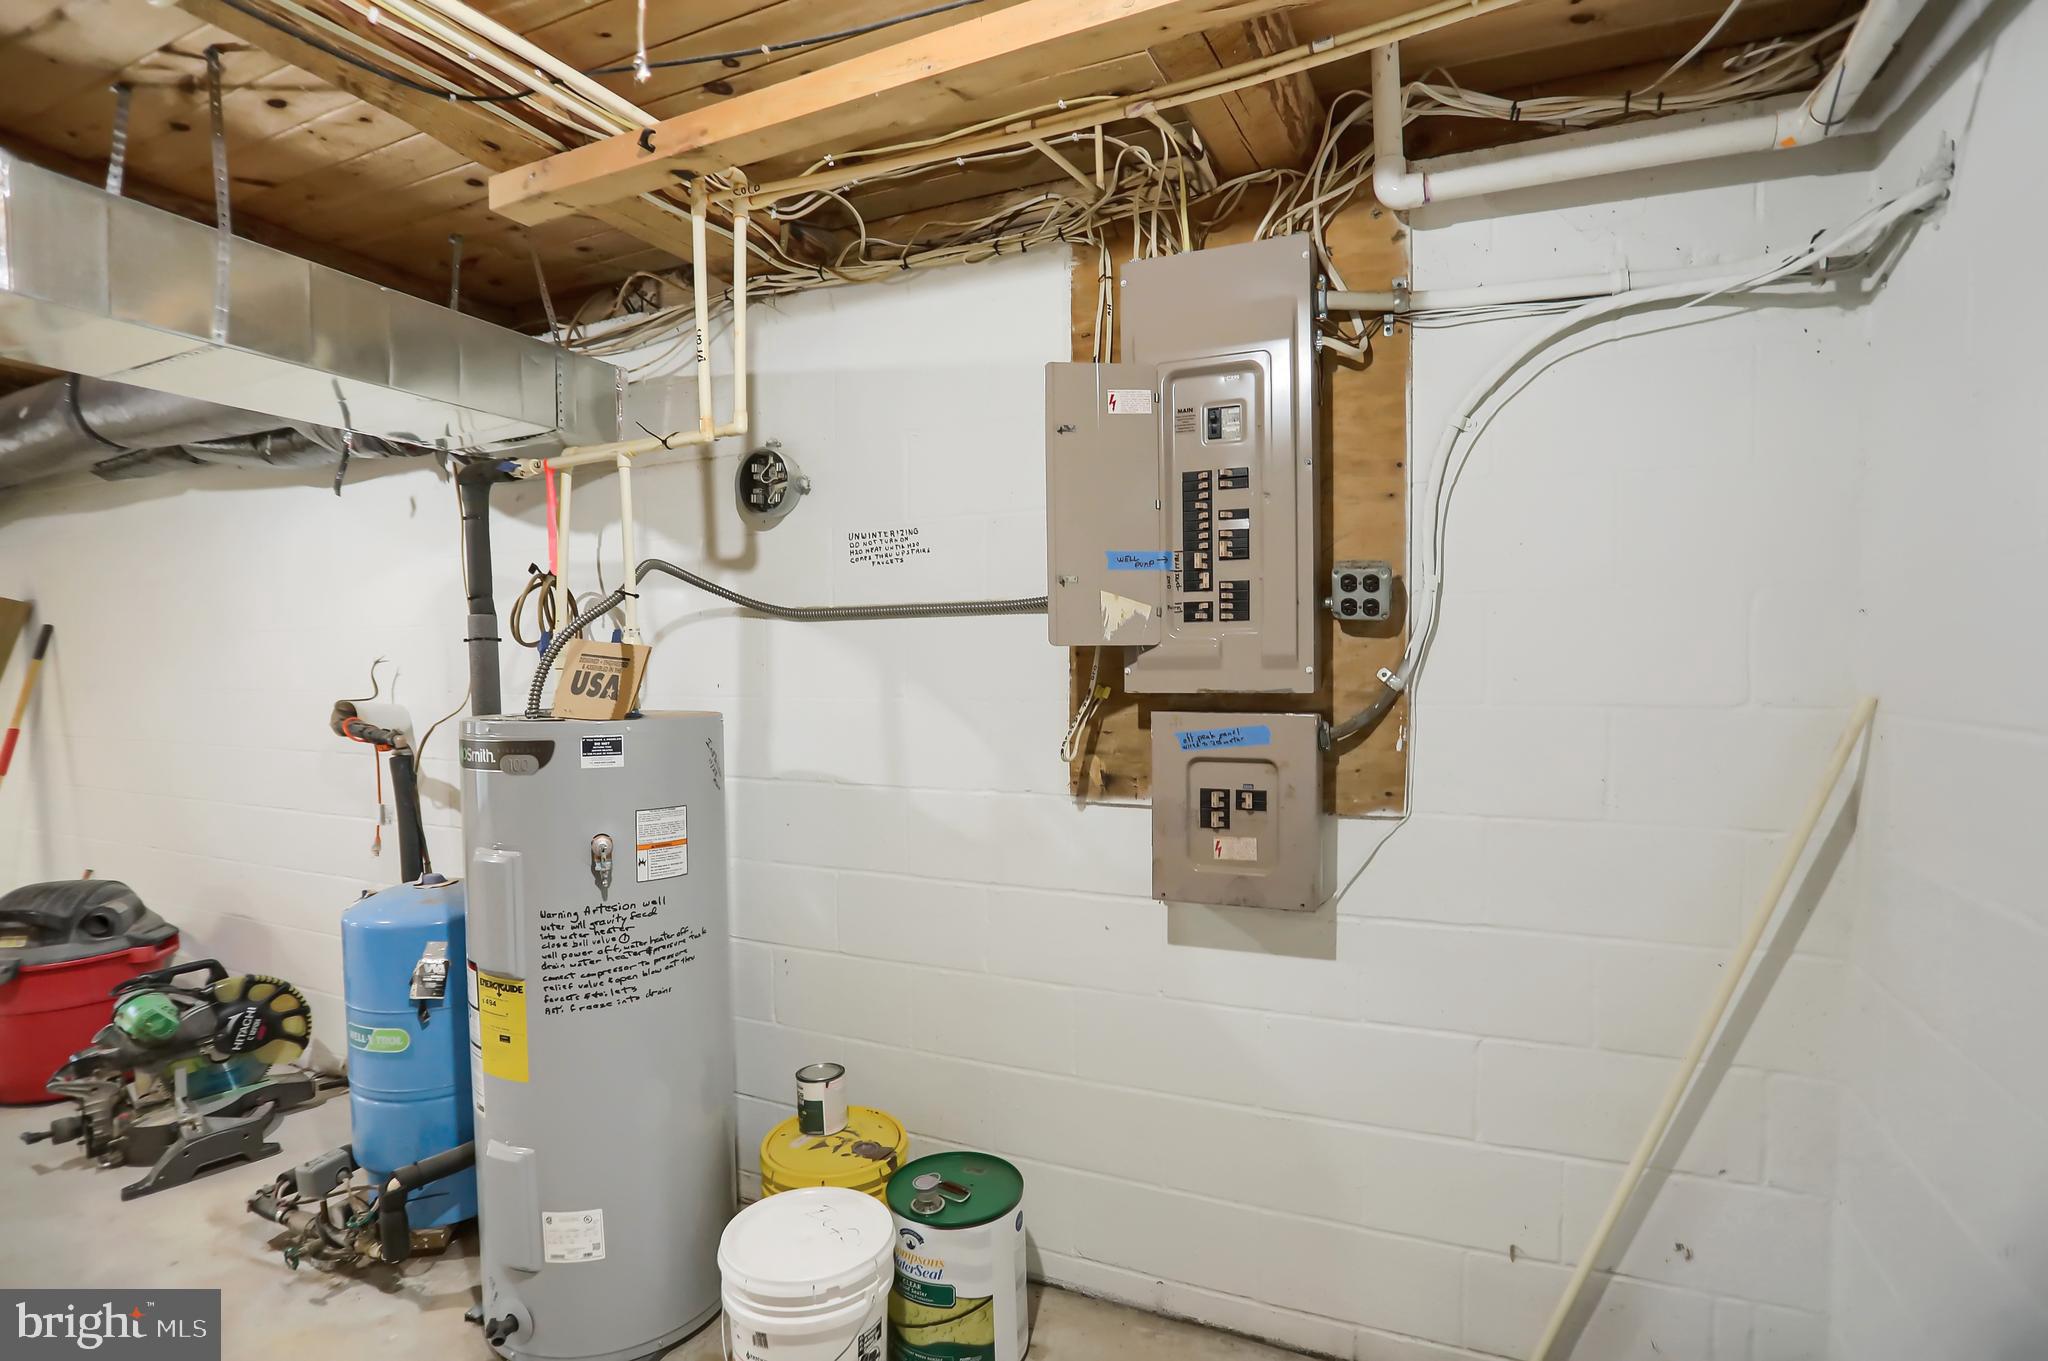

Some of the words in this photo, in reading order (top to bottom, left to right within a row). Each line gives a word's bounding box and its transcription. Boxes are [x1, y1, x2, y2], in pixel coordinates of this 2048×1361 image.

[848, 528, 919, 540] UNWINTERIZING
[849, 541, 860, 549] DO
[862, 539, 877, 547] NOT
[1117, 555, 1140, 563] WELL
[571, 669, 619, 702] USA
[540, 910, 579, 924] Warning
[642, 895, 666, 906] well
[589, 914, 628, 931] gravity
[561, 950, 593, 961] power
[231, 1006, 258, 1051] HITACHI
